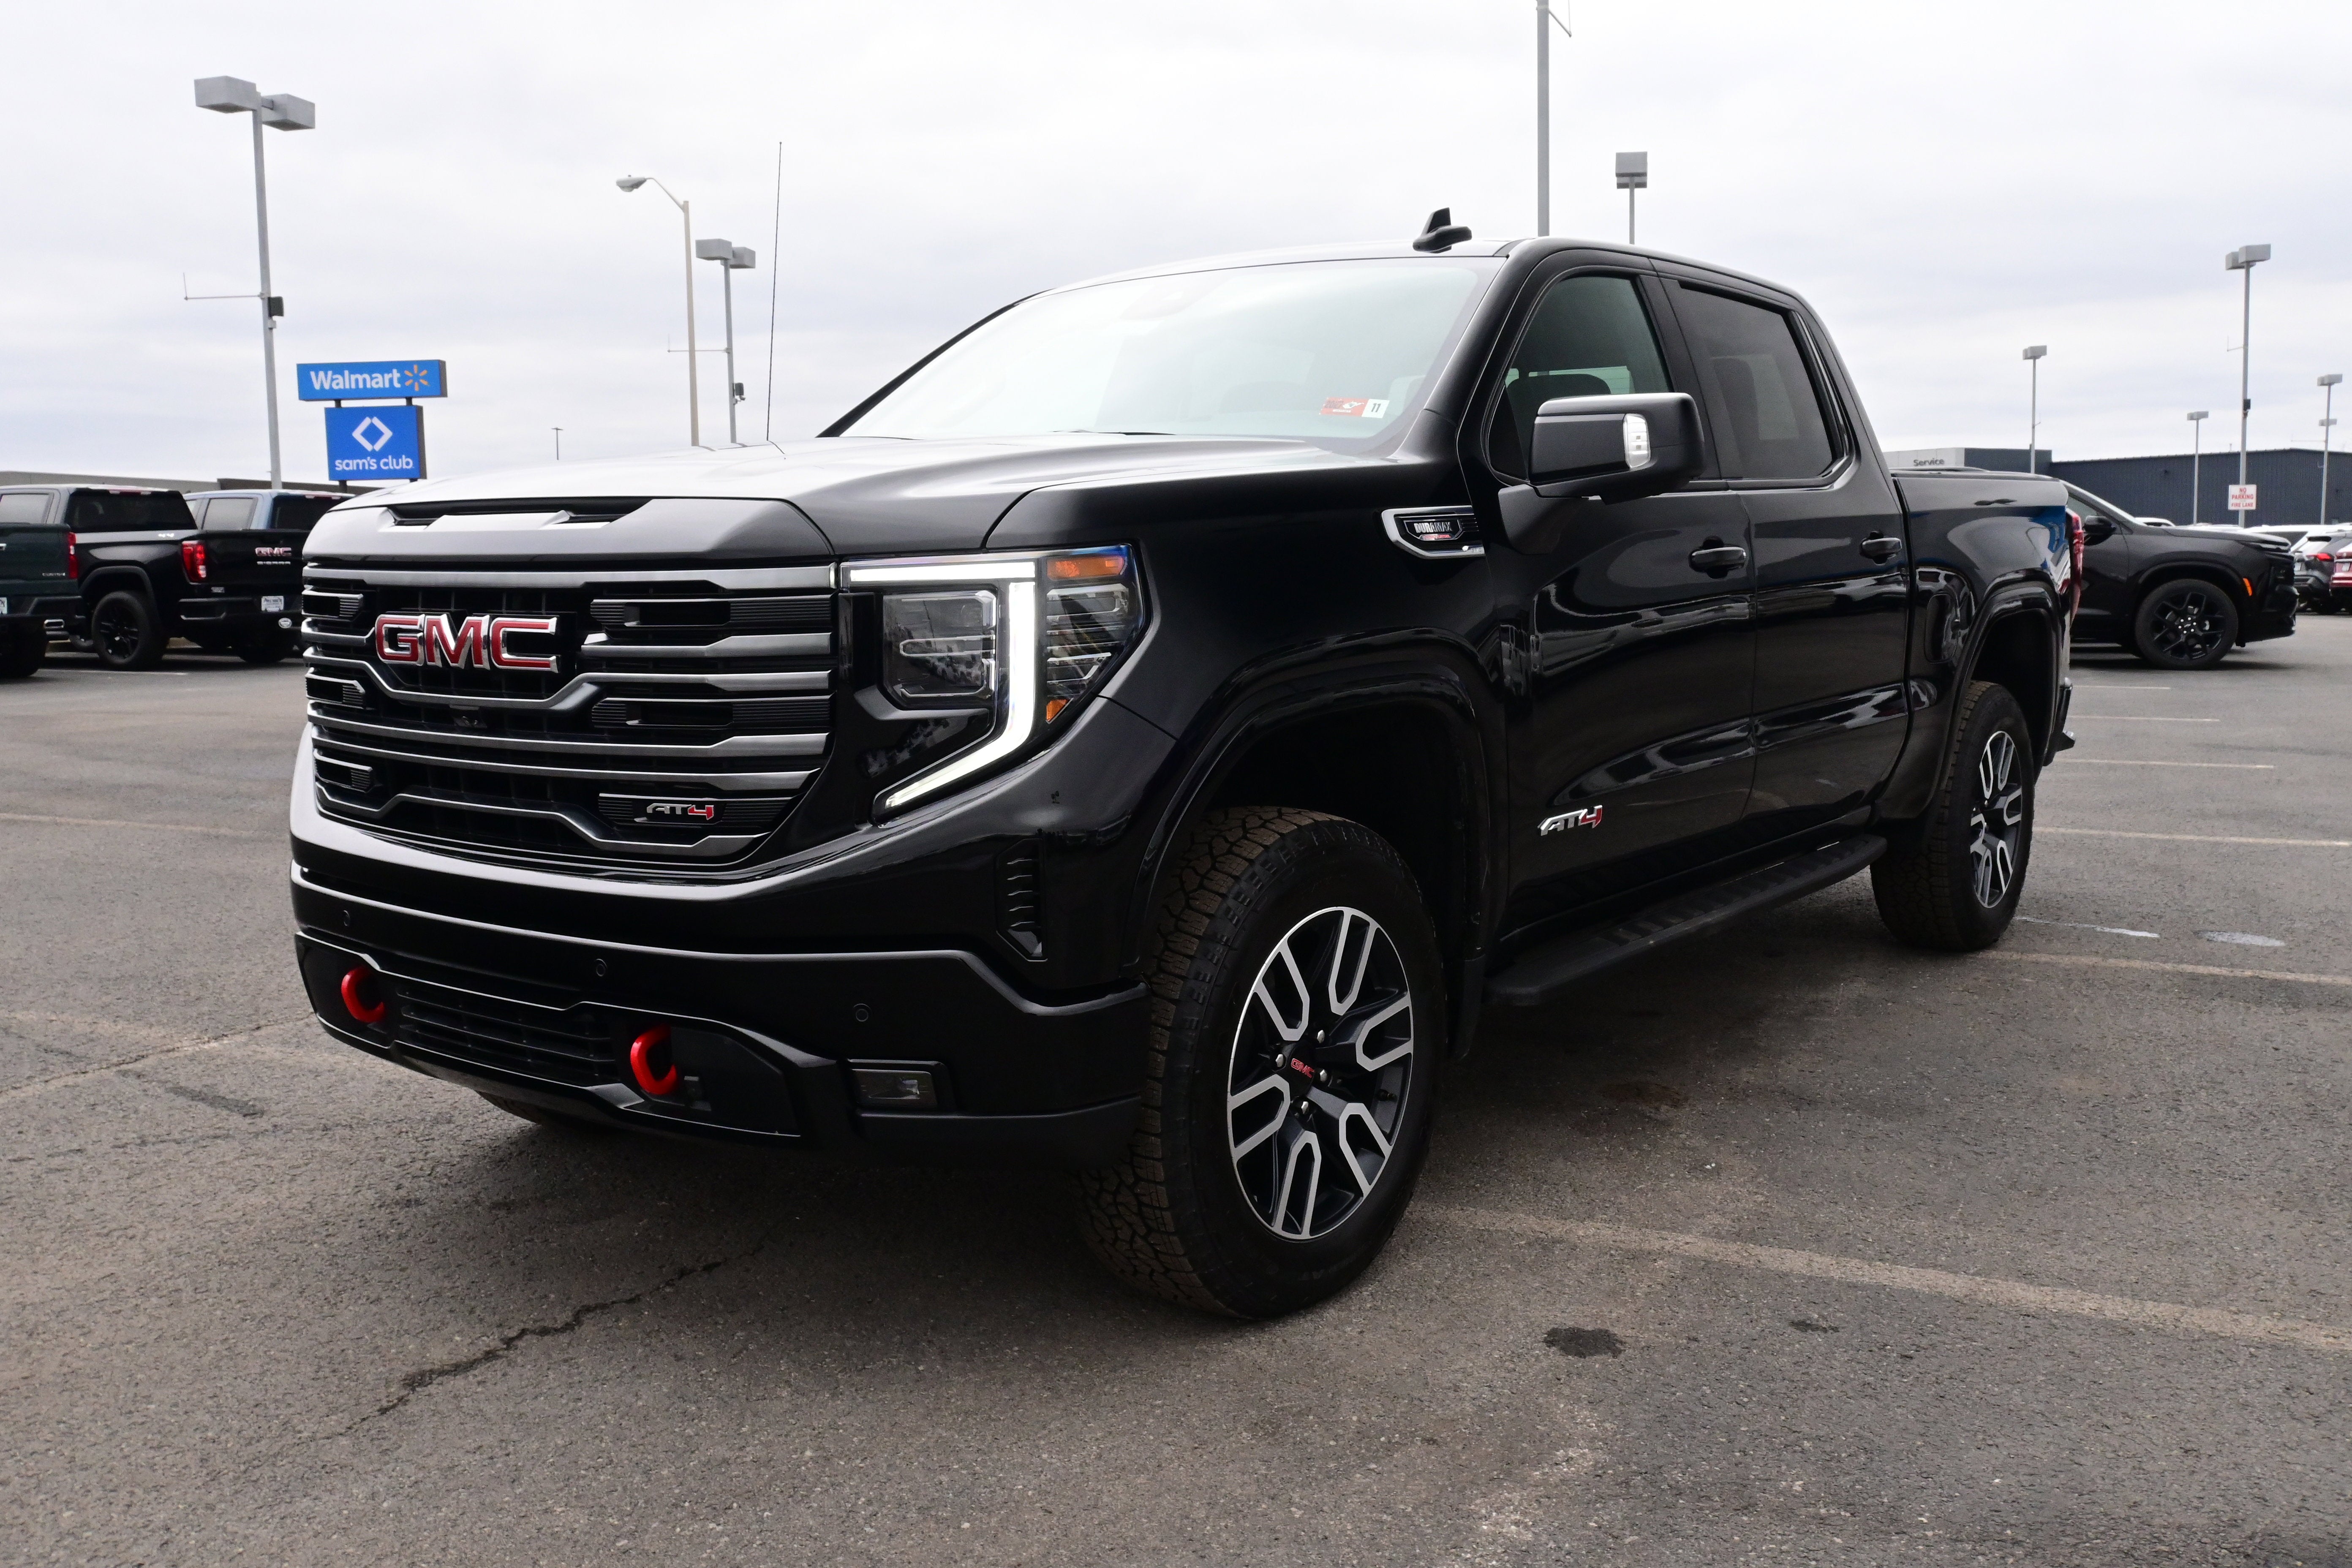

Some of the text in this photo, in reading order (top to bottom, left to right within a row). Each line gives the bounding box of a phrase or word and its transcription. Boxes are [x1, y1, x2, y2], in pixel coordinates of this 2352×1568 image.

[310, 368, 401, 389] Walmart
[1371, 403, 1381, 412] 11
[335, 455, 413, 471] sam's club
[1914, 457, 1944, 466] Service
[1413, 522, 1452, 533] DURAMAX
[255, 547, 291, 557] GMC
[376, 614, 557, 672] GMC
[646, 802, 714, 820] AT4
[1538, 805, 1603, 836] AT4
[1291, 1058, 1314, 1078] GMC
